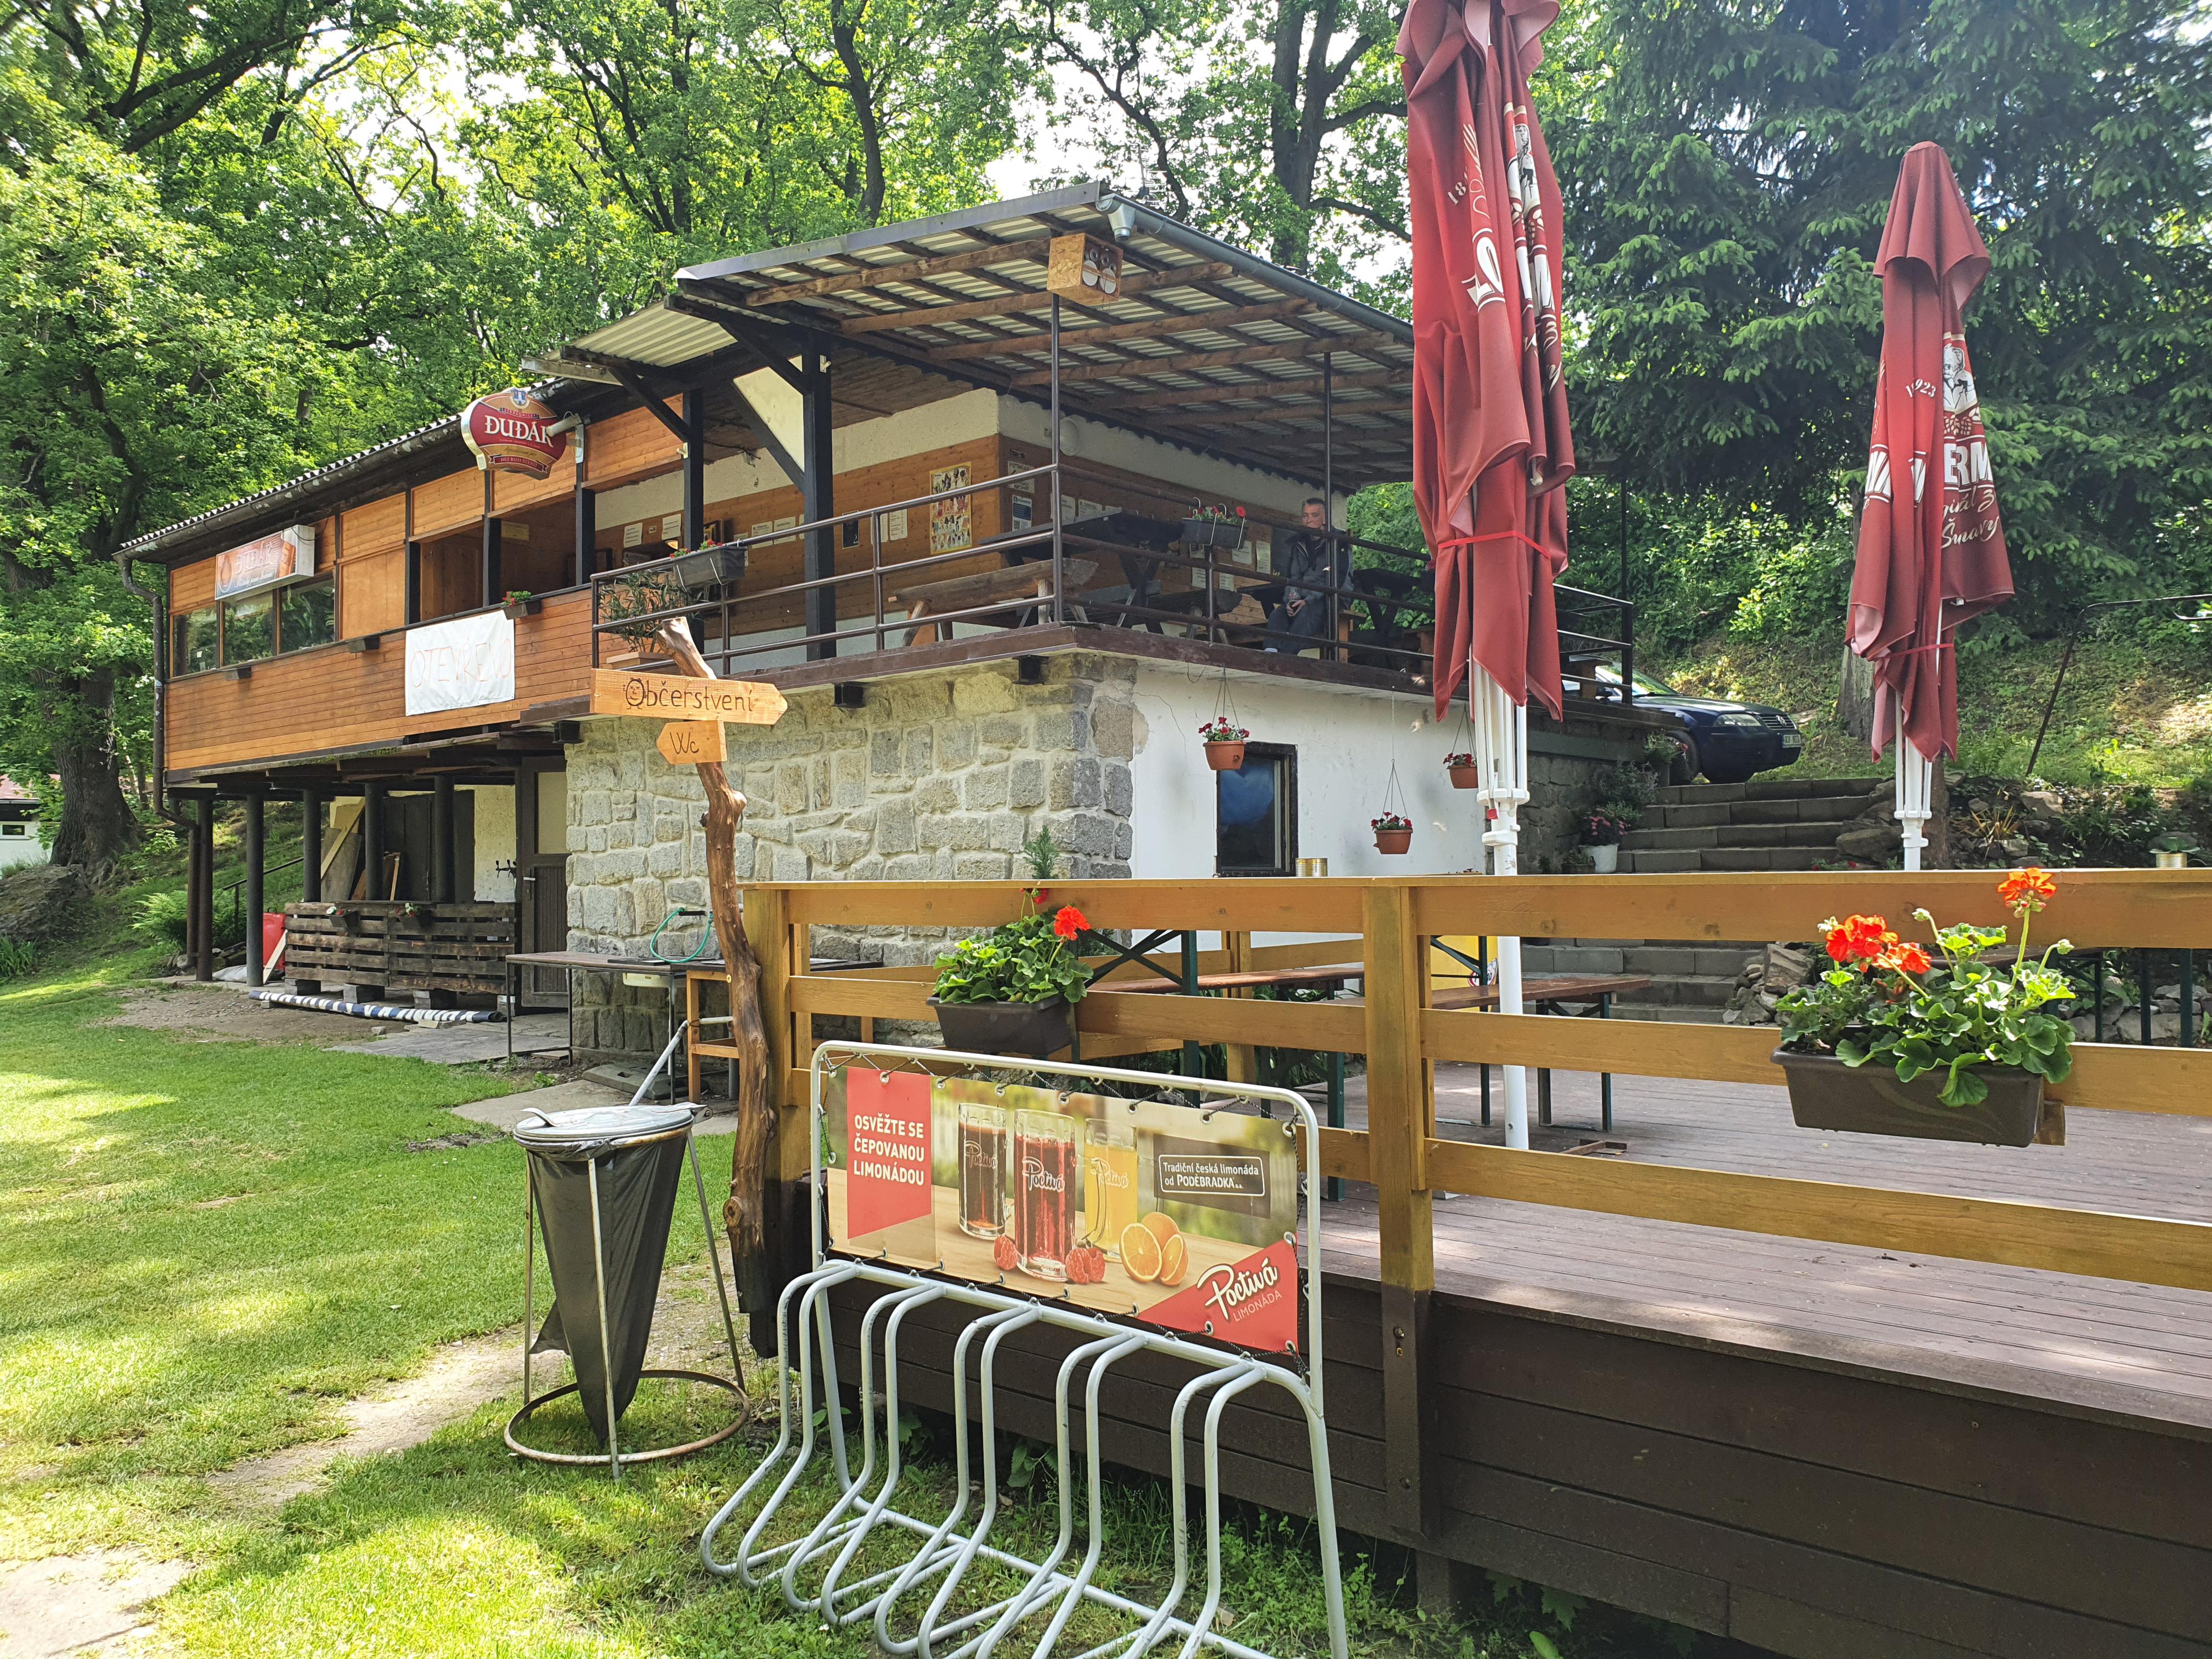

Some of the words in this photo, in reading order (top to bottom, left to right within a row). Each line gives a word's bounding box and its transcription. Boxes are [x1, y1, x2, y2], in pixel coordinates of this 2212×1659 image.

[624, 677, 753, 712] Občerstvení
[854, 1112, 906, 1136] OSVĚŽTE
[908, 1121, 924, 1139] SE
[854, 1132, 925, 1162] ČEPOVANOU
[853, 1160, 924, 1186] LIMONÁDOU
[1021, 1156, 1066, 1192] Poctivá
[1162, 1162, 1194, 1173] Tradiční
[1196, 1162, 1219, 1174] česká
[1220, 1164, 1259, 1176] limonáda
[1165, 1175, 1174, 1186] od
[1197, 1257, 1279, 1321] Poctivá
[1233, 1290, 1283, 1322] LIMONÁDA
